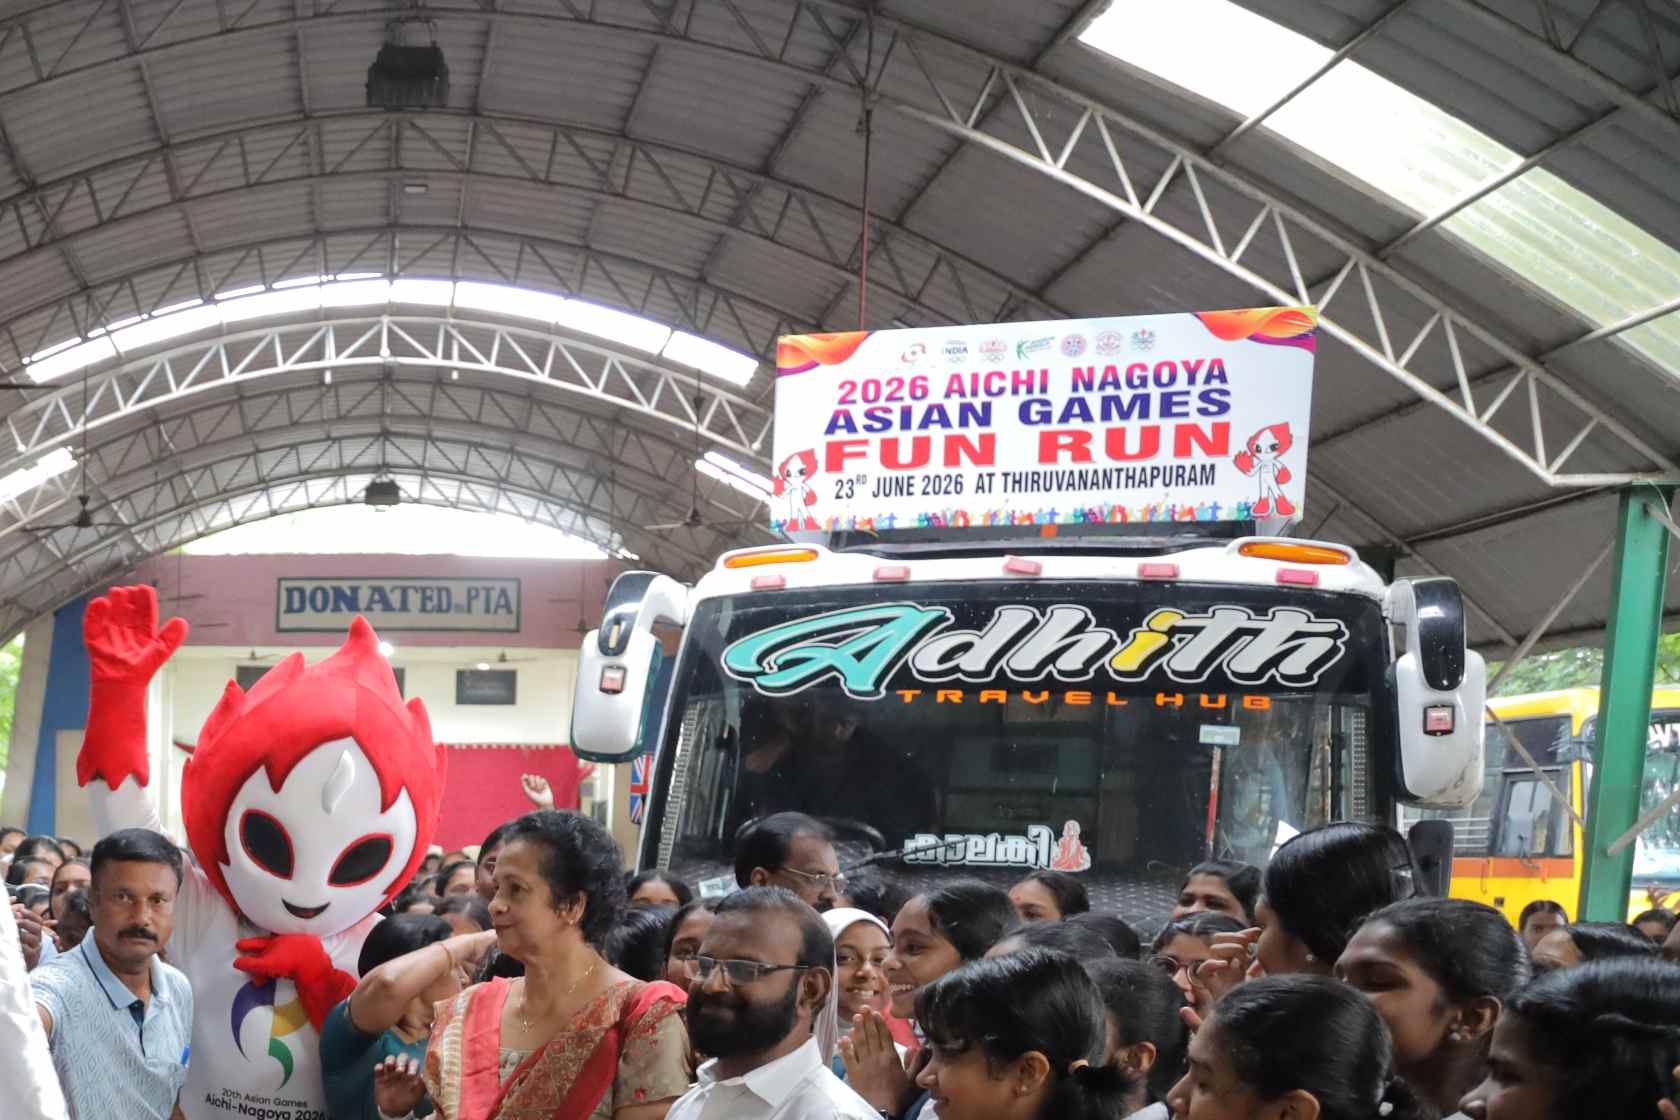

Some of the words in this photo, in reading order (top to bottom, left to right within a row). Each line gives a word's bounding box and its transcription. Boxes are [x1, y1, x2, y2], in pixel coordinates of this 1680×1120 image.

[837, 375, 929, 405] 2026
[944, 368, 1049, 399] AICHI
[1071, 358, 1229, 393] NAGOYA
[824, 401, 992, 435] ASIAN
[1018, 388, 1231, 426] GAMES
[825, 433, 996, 473] FUN
[1038, 422, 1230, 465] RUN
[872, 476, 915, 498] JUNE
[921, 474, 964, 496] 2026
[975, 473, 996, 494] AT
[1001, 463, 1216, 493] THIRUVANANTHAPURAM
[283, 585, 452, 614] DONATED
[467, 586, 513, 615] PTA
[721, 602, 1349, 700] Adhith
[896, 689, 1129, 706] TRAVEL
[1155, 692, 1271, 709] HUB
[244, 1093, 271, 1105] Asian
[273, 1097, 308, 1108] Games
